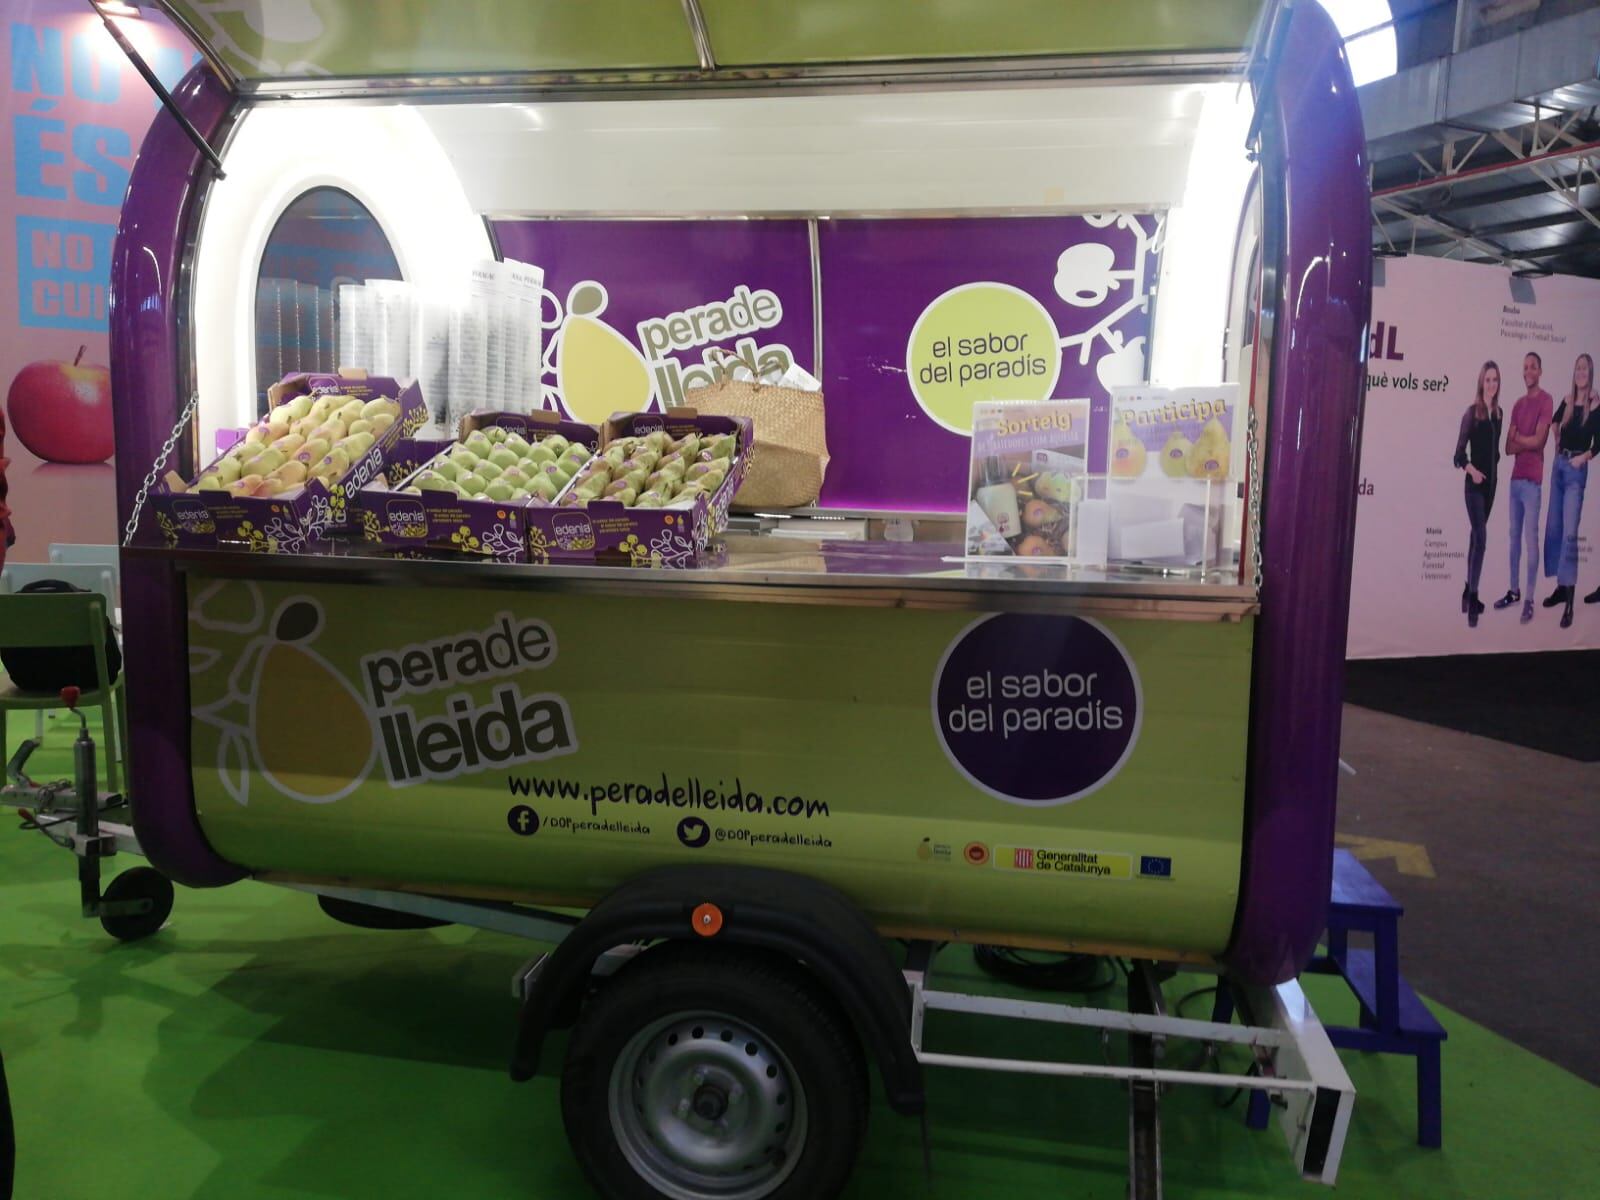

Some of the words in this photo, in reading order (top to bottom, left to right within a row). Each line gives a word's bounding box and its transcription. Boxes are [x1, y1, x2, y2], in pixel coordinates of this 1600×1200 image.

[10, 21, 122, 105] NO
[13, 97, 131, 206] ÉS
[32, 229, 94, 273] NO
[932, 336, 952, 357] el
[958, 332, 1028, 355] sabor
[919, 363, 953, 385] del
[959, 352, 1047, 387] paradís
[1366, 371, 1388, 391] què
[1392, 372, 1419, 390] vols
[1423, 375, 1449, 392] ser?
[997, 410, 1072, 437] Sorteig
[1121, 398, 1227, 426] Participa
[345, 447, 383, 499] edenia
[176, 509, 209, 520] edenia
[389, 509, 424, 522] edenia
[555, 521, 591, 536] edenia
[966, 671, 992, 699] el
[1001, 668, 1098, 699] sabor
[948, 704, 994, 733] del
[1002, 699, 1124, 740] paradís
[379, 689, 571, 782] lleida
[508, 772, 830, 818] www.peradelleida.com
[1036, 849, 1098, 864] Generalitat
[1036, 860, 1051, 870] de
[1054, 861, 1111, 877] Catalunya
